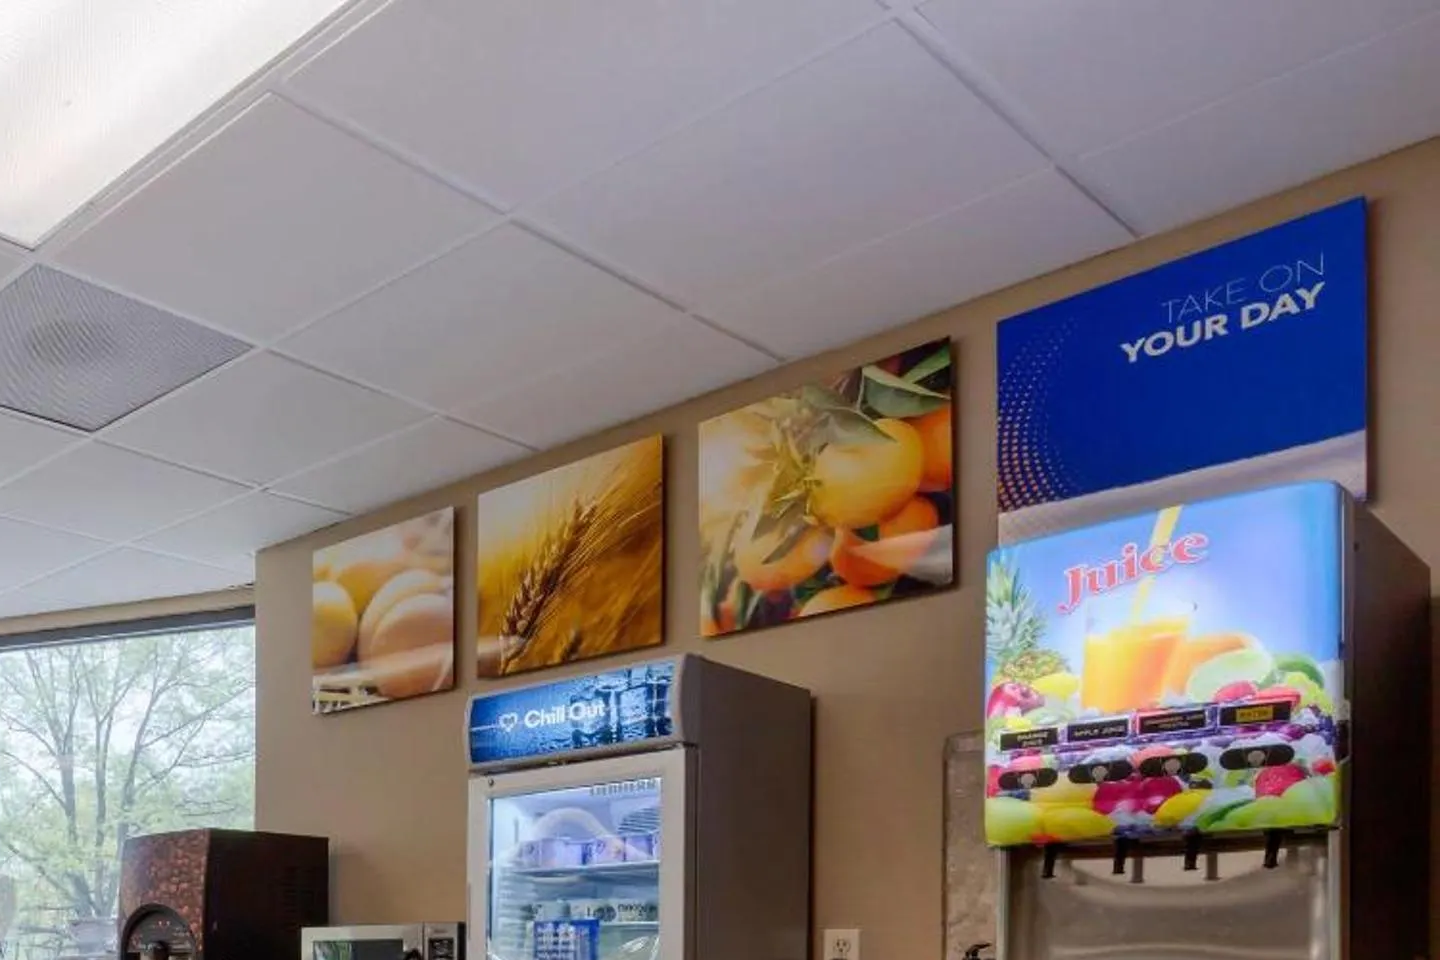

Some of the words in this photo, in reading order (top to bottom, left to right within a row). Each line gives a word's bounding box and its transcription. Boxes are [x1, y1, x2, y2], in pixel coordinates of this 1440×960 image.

[1120, 314, 1229, 363] YOUR
[1240, 281, 1325, 329] DAY
[1161, 278, 1247, 324] TAKE
[1259, 251, 1325, 293] ON
[1057, 532, 1209, 614] Juice
[524, 705, 565, 729] Chill
[569, 698, 606, 720] Out
